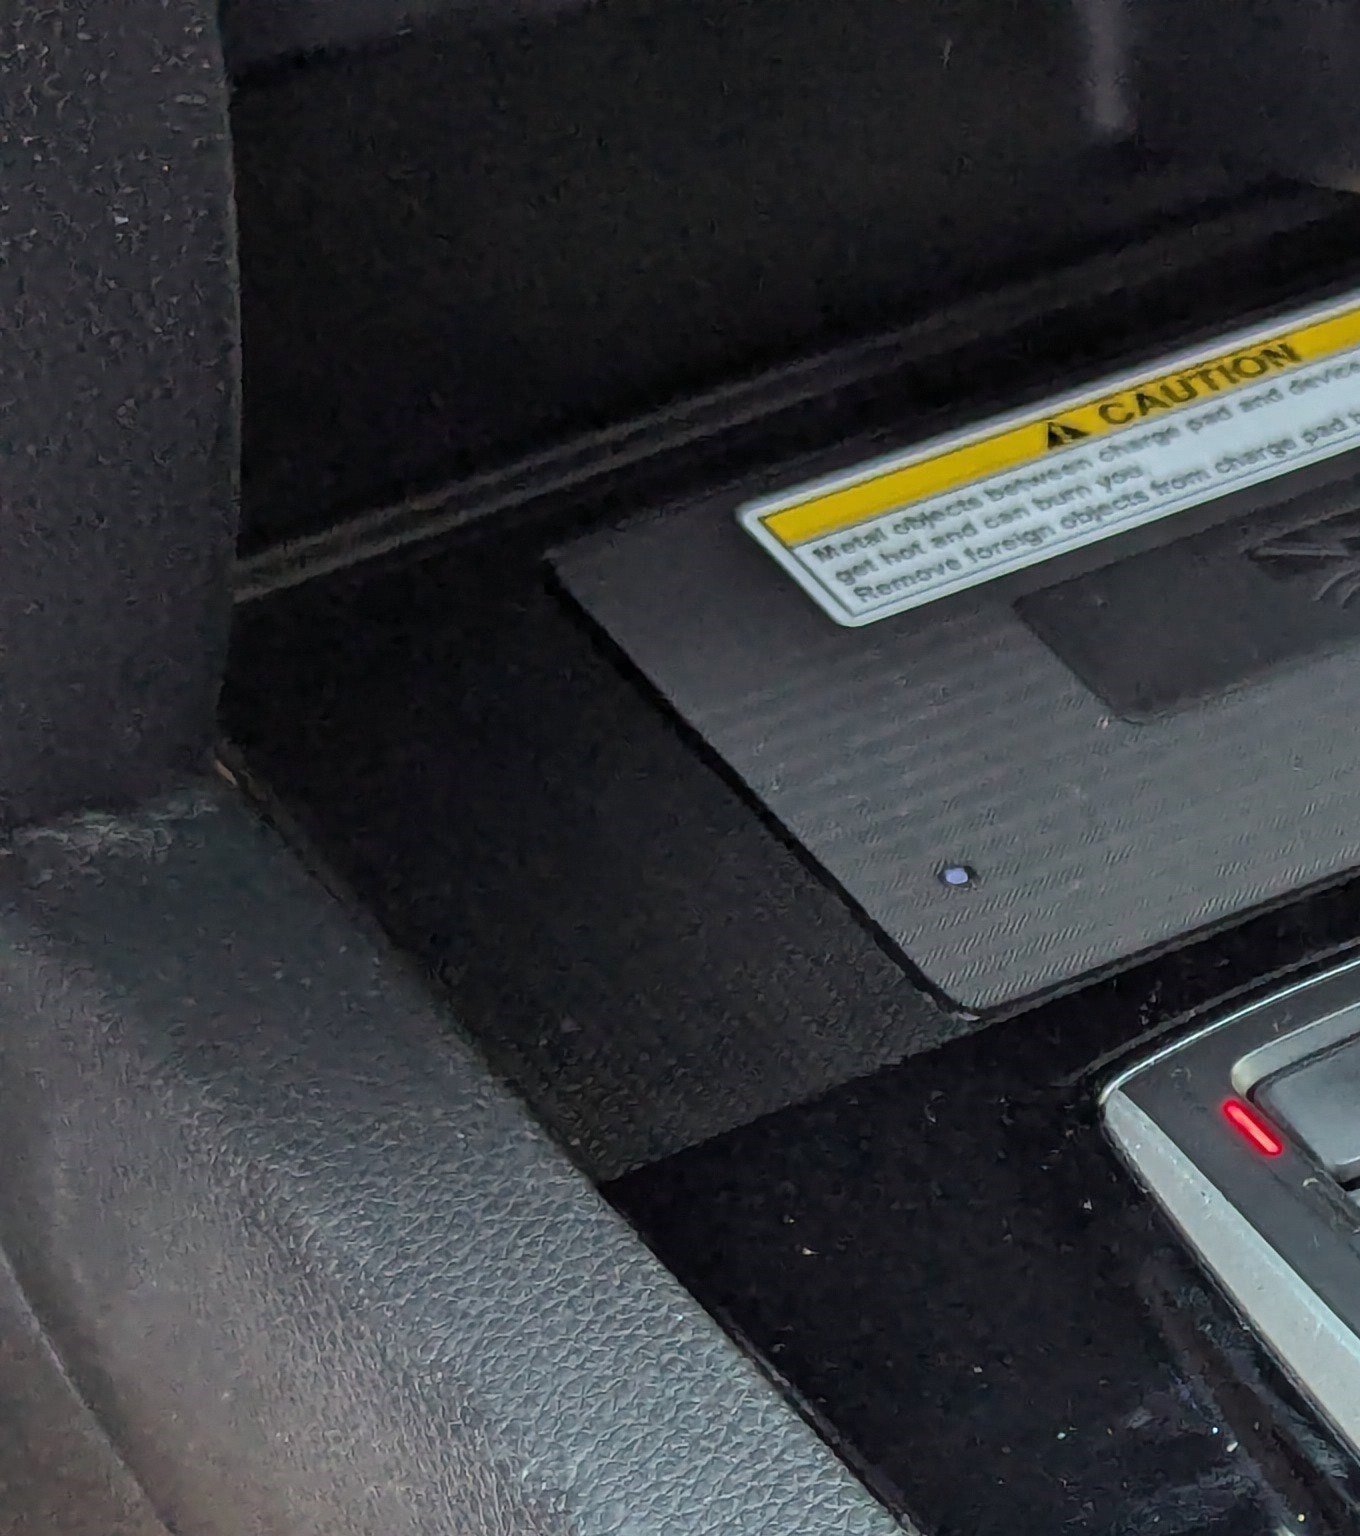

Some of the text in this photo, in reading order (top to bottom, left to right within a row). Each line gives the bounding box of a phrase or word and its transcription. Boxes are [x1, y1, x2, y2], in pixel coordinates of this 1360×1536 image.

[1098, 343, 1301, 425] CAUTION
[813, 528, 888, 562] Metal
[893, 499, 984, 535] objects
[985, 458, 1093, 501] between
[1100, 427, 1179, 462] charge
[1186, 406, 1233, 433] pad
[1239, 387, 1283, 412] and
[836, 559, 879, 586] get
[879, 541, 926, 566] hot
[931, 522, 976, 549] and
[985, 505, 1031, 529] can
[1032, 485, 1092, 511] burn
[853, 557, 961, 602] Remove
[964, 523, 1055, 563] foreign
[1060, 490, 1149, 530] objects
[1151, 470, 1211, 495] from
[1215, 438, 1296, 474] charge
[1303, 417, 1346, 446] pad
